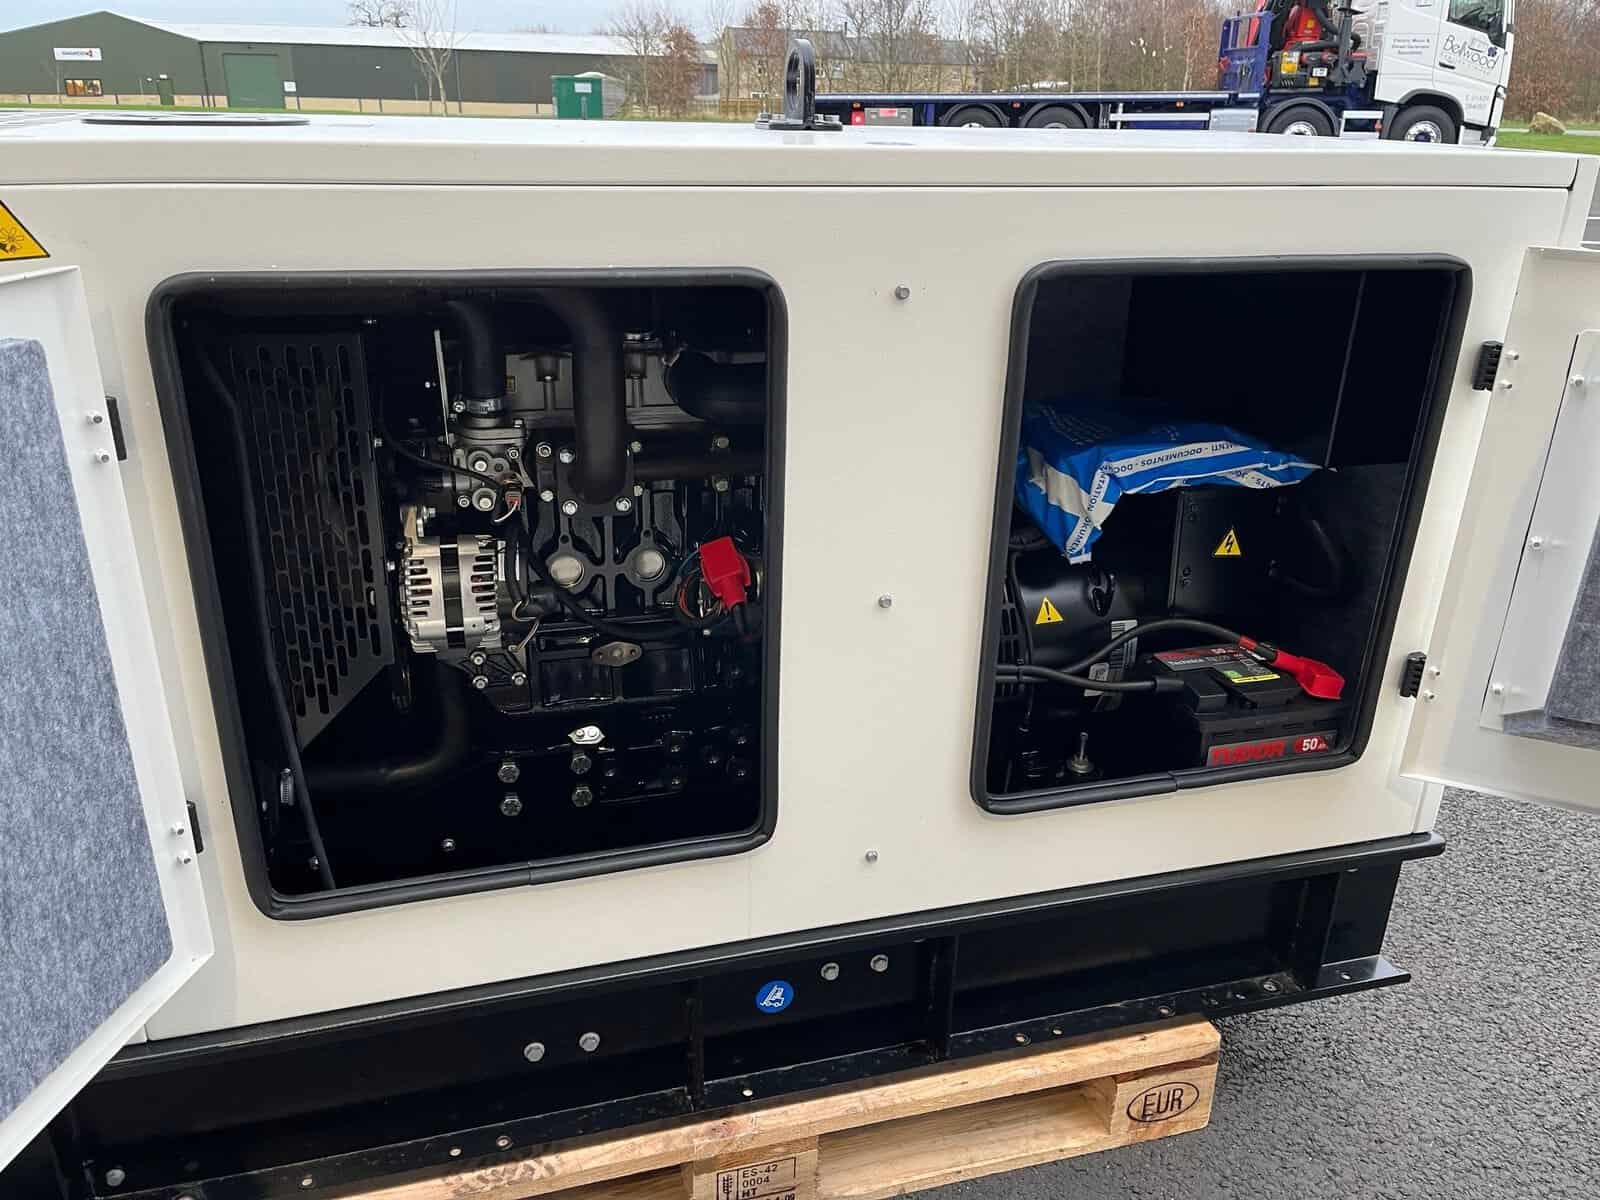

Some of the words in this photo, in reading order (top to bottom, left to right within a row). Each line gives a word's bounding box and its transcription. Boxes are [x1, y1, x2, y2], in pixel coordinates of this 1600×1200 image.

[1141, 448, 1202, 467] DOCUMENTOS
[1302, 738, 1318, 752] 50
[1141, 1088, 1184, 1119] EUR
[742, 1164, 778, 1179] ES-42
[742, 1176, 770, 1189] 0004
[742, 1187, 758, 1198] HT
